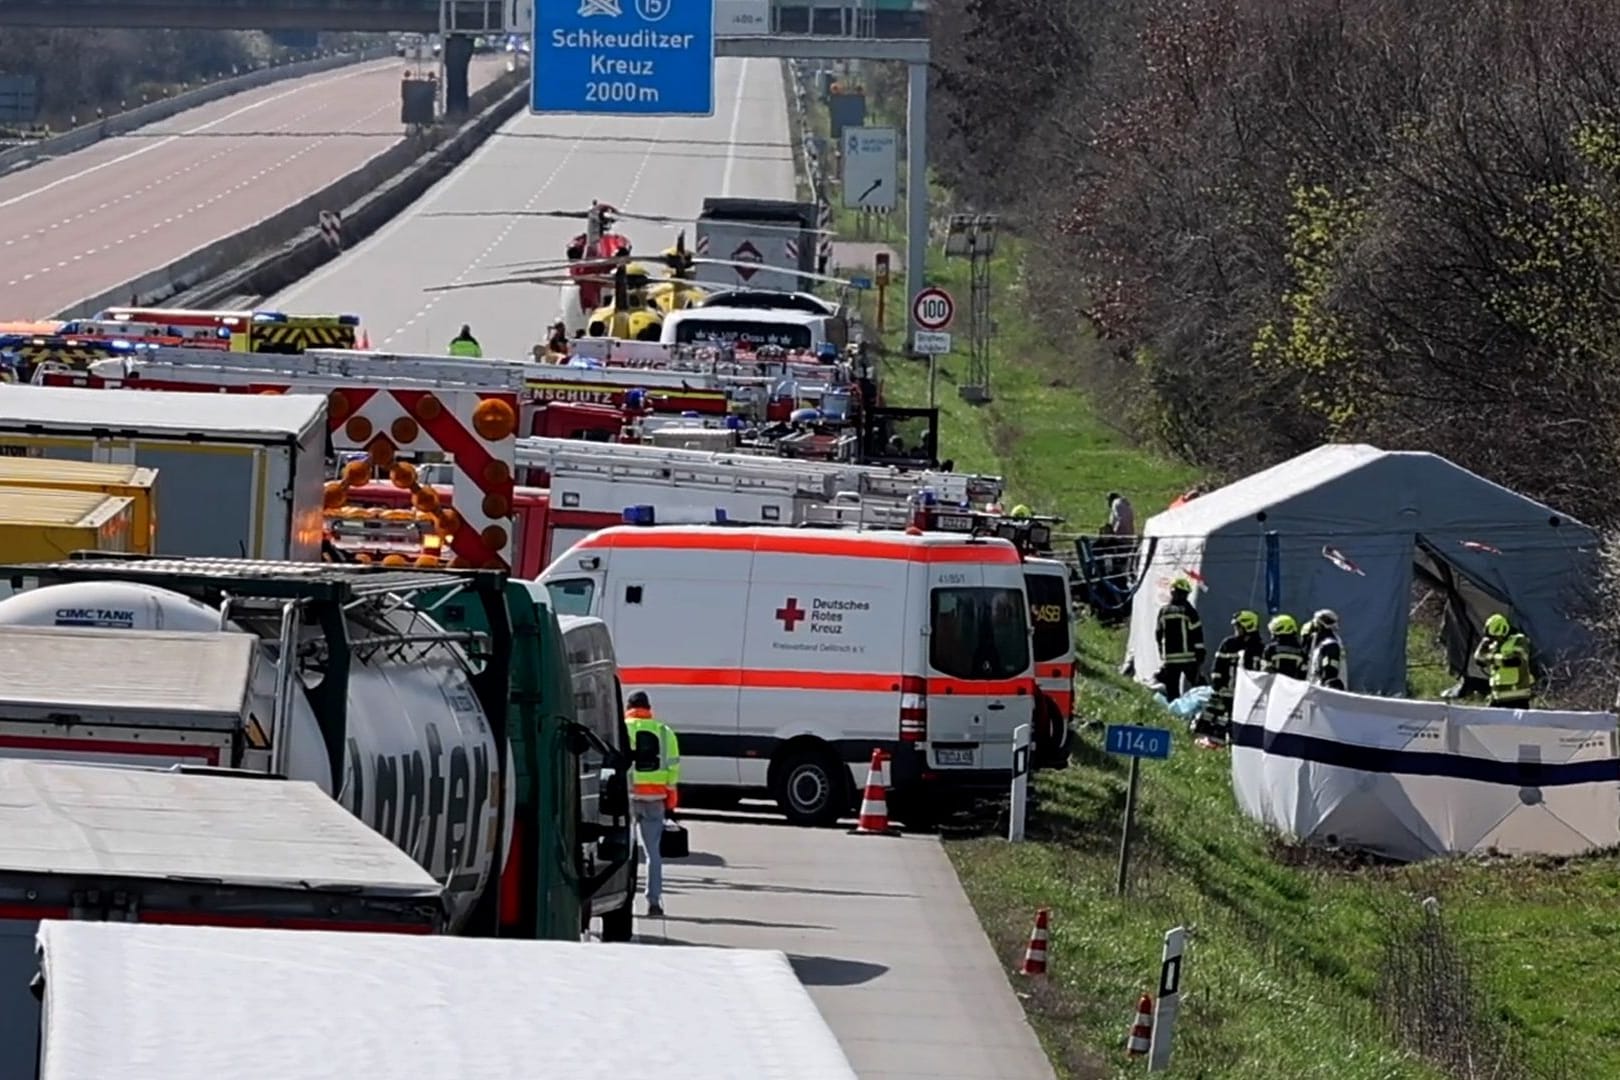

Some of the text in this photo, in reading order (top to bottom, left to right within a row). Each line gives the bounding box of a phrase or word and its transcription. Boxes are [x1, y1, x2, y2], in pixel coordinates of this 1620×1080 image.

[552, 29, 694, 48] Schkeuditzer
[591, 55, 653, 75] Kreuz
[923, 300, 946, 319] 100
[813, 598, 870, 610] Deutsches
[1039, 604, 1061, 622] ASB
[56, 608, 134, 621] CIMC TANK
[811, 611, 843, 622] Rotes
[811, 623, 842, 634] Kreuz
[1116, 730, 1159, 753] 114.0
